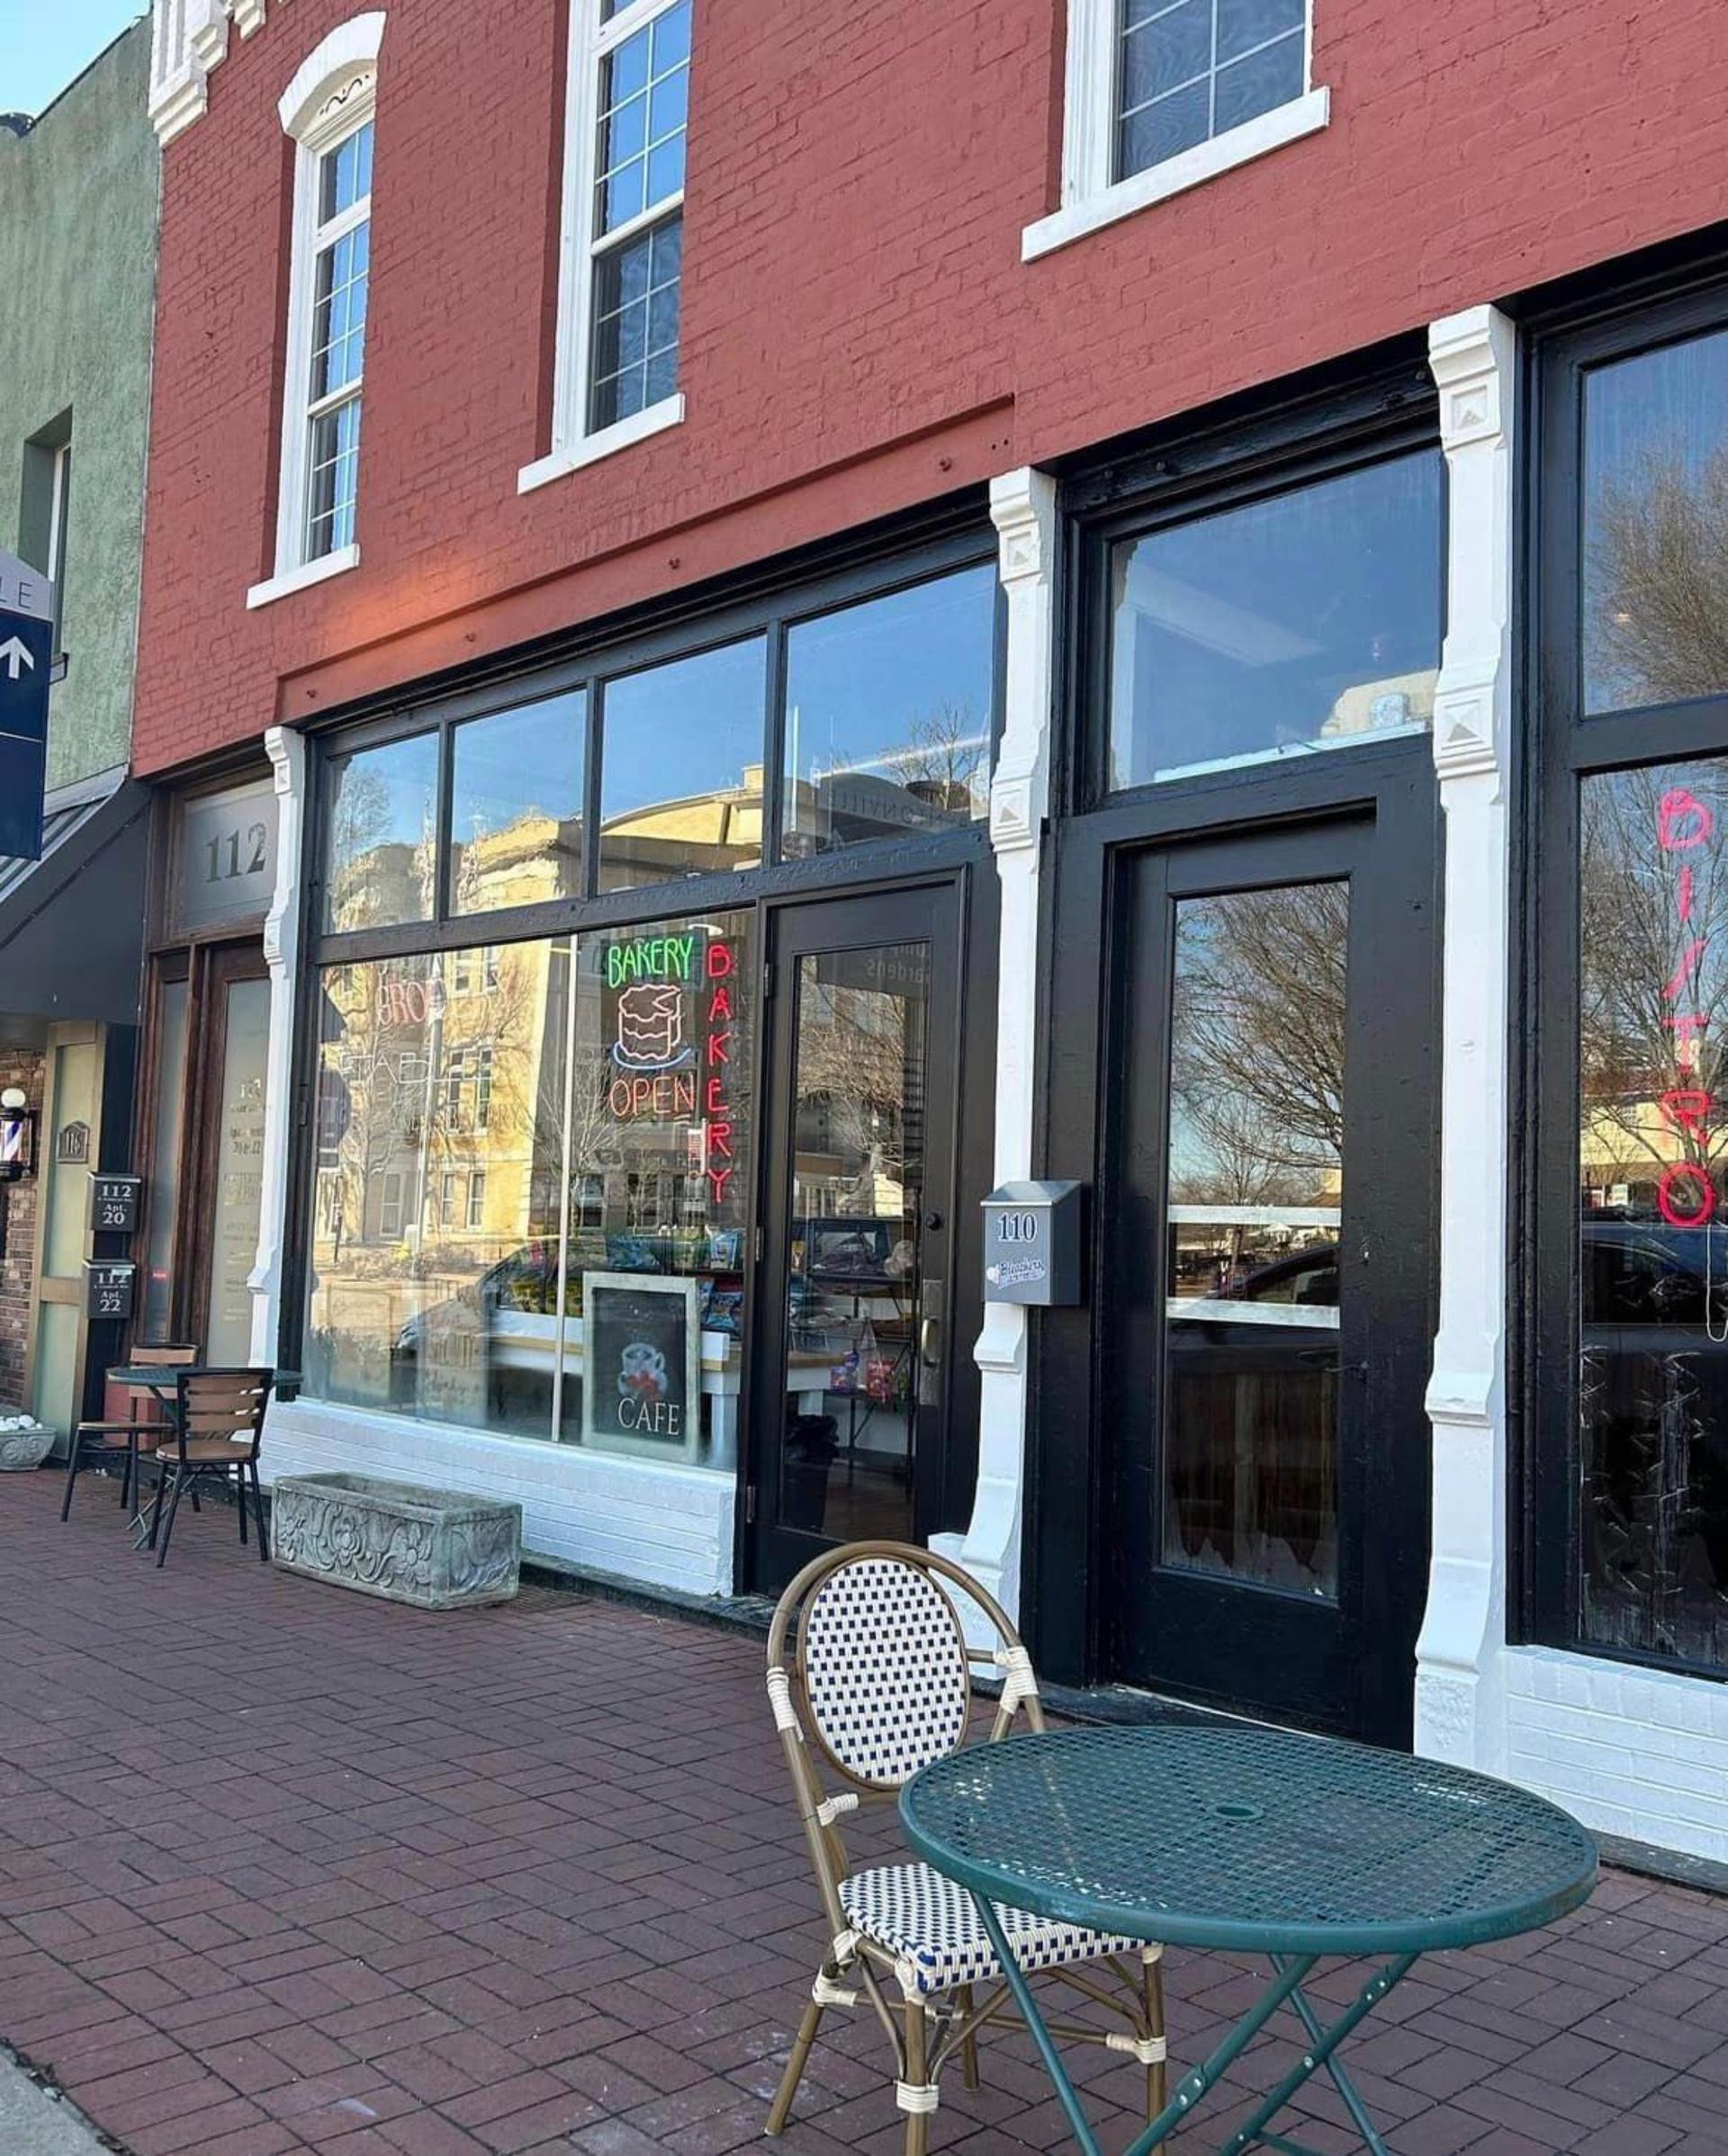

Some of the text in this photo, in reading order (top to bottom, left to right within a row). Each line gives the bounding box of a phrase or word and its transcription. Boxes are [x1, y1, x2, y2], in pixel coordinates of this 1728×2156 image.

[204, 822, 266, 883] 112
[608, 937, 694, 989] BAKERY
[608, 1071, 695, 1118] OPEN
[102, 1184, 131, 1197] 112
[102, 1211, 125, 1225] 20
[998, 1212, 1037, 1242] 110
[100, 1298, 121, 1312] 22
[617, 1397, 680, 1435] CAFE
